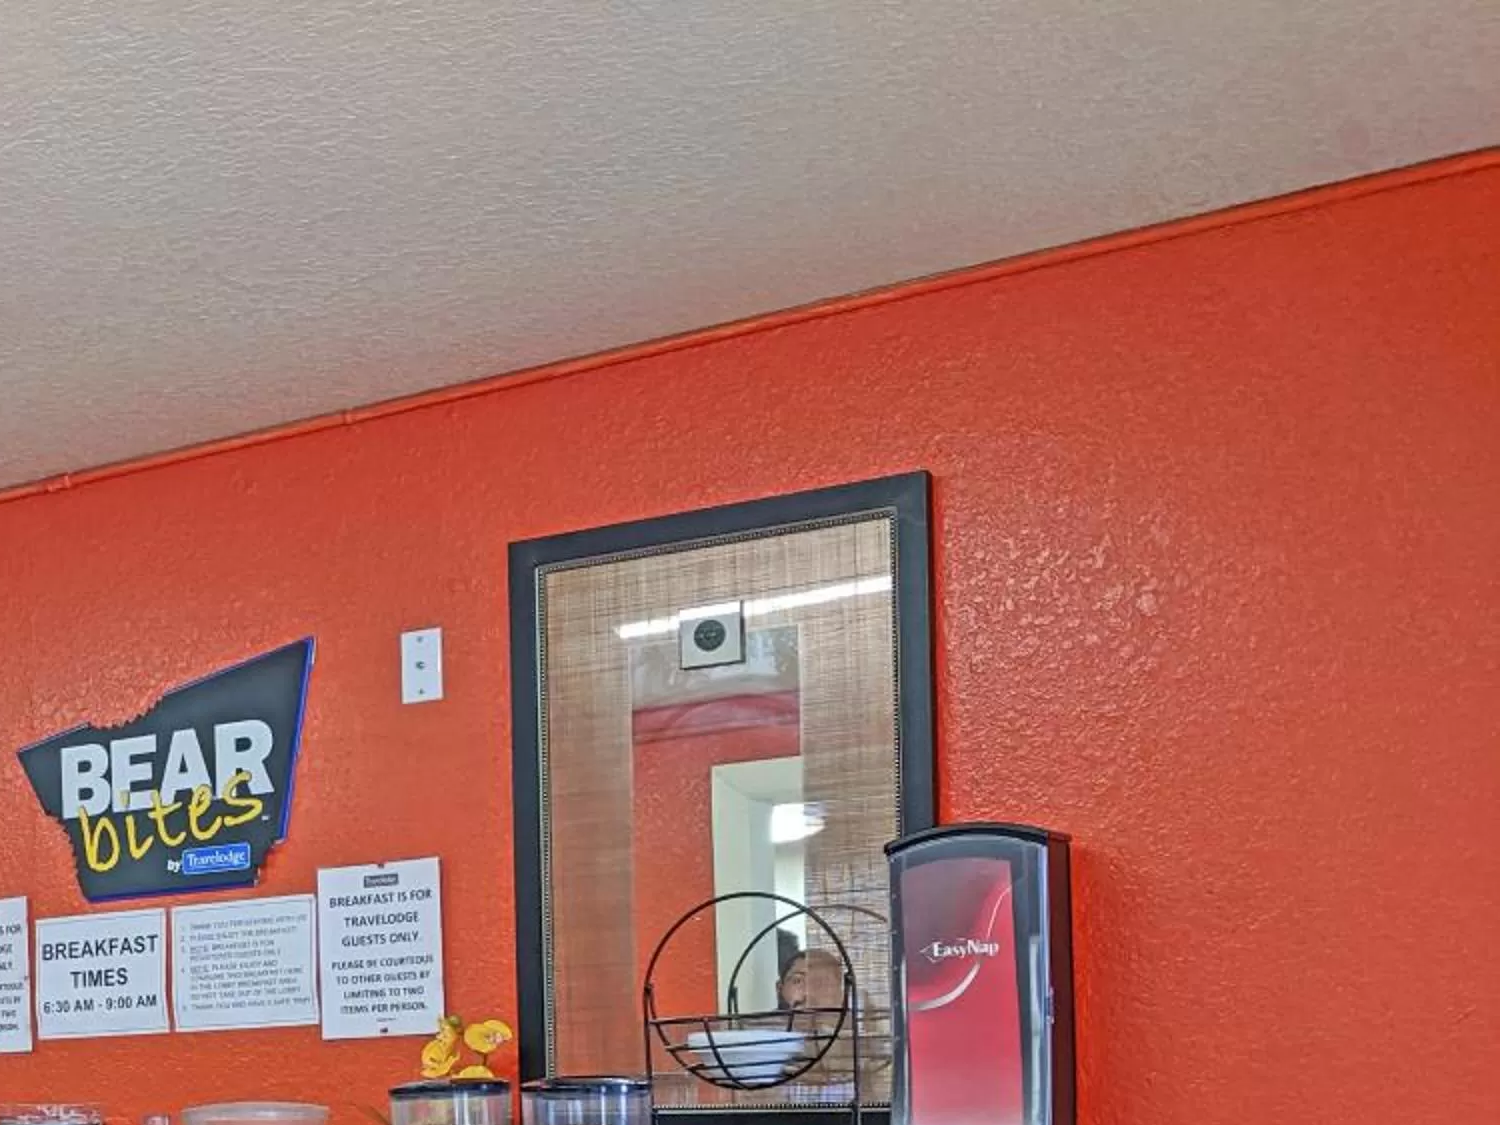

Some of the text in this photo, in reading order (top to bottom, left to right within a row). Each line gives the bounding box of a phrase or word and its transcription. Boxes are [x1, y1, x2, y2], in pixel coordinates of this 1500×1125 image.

[61, 719, 275, 820] BEAR
[78, 771, 263, 872] bites
[167, 847, 246, 873] by Travelodge
[329, 888, 432, 908] BREAKFAST IS FOR
[344, 911, 419, 928] TRAVELODGE
[42, 933, 159, 961] BREAKFAST
[341, 933, 386, 947] GUESTS
[932, 939, 999, 958] EasyNap
[331, 959, 364, 971] PLEASE
[69, 967, 128, 989] TIMES
[336, 975, 349, 985] TO
[351, 973, 381, 985] OTHER
[389, 986, 401, 997] TO
[402, 985, 425, 995] TWO
[43, 1000, 70, 1014] 6:30
[74, 997, 95, 1012] AM
[105, 995, 132, 1010] 9:00
[136, 994, 157, 1008] AM
[371, 1003, 389, 1013] PER
